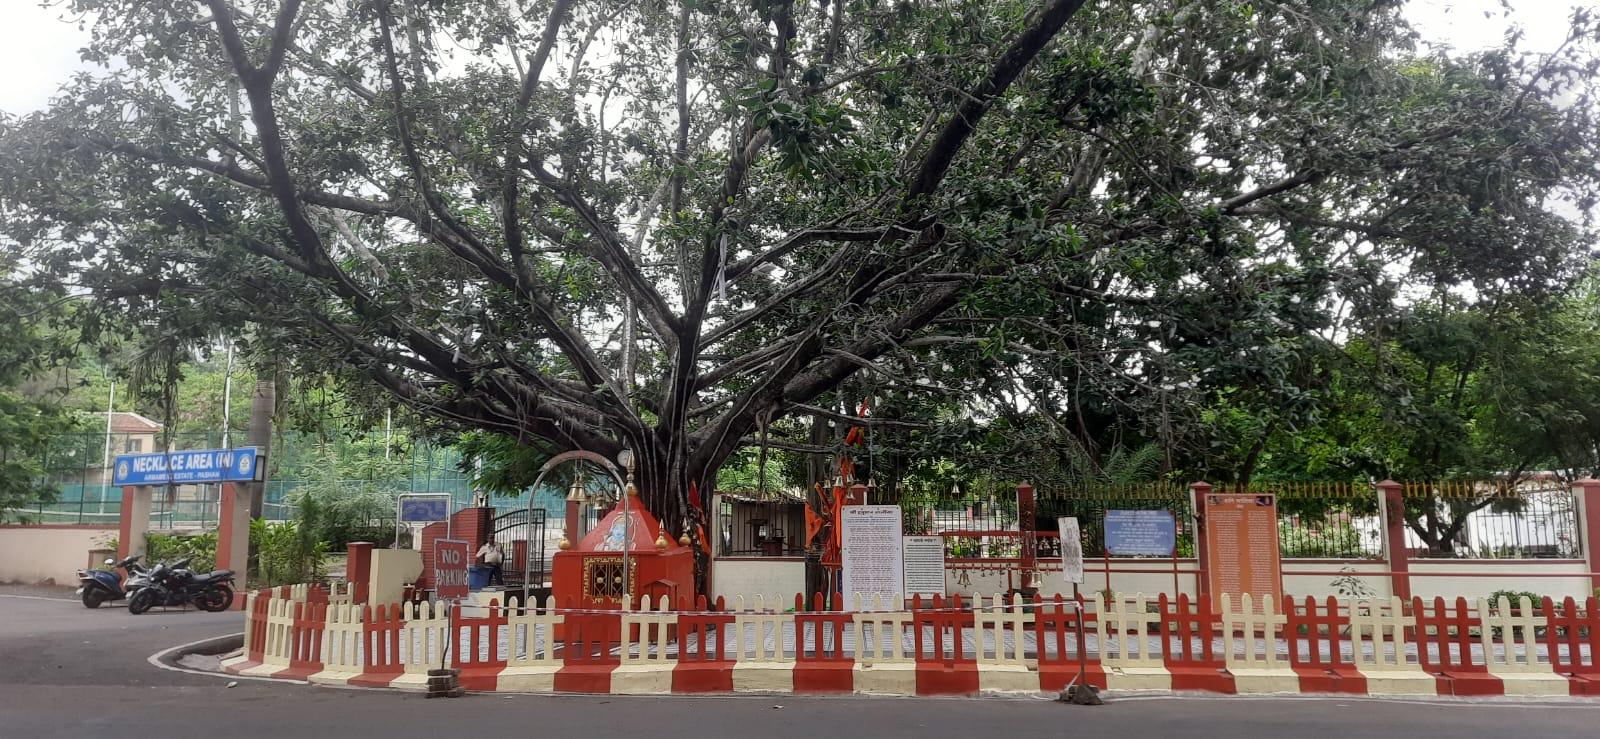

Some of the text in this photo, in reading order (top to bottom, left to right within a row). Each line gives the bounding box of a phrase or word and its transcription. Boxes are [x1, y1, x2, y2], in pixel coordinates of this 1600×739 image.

[185, 453, 213, 470] AREA
[215, 452, 234, 469] (IN)
[173, 472, 194, 480] ESTATE
[442, 549, 459, 564] NO
[436, 569, 467, 585] PARKING
